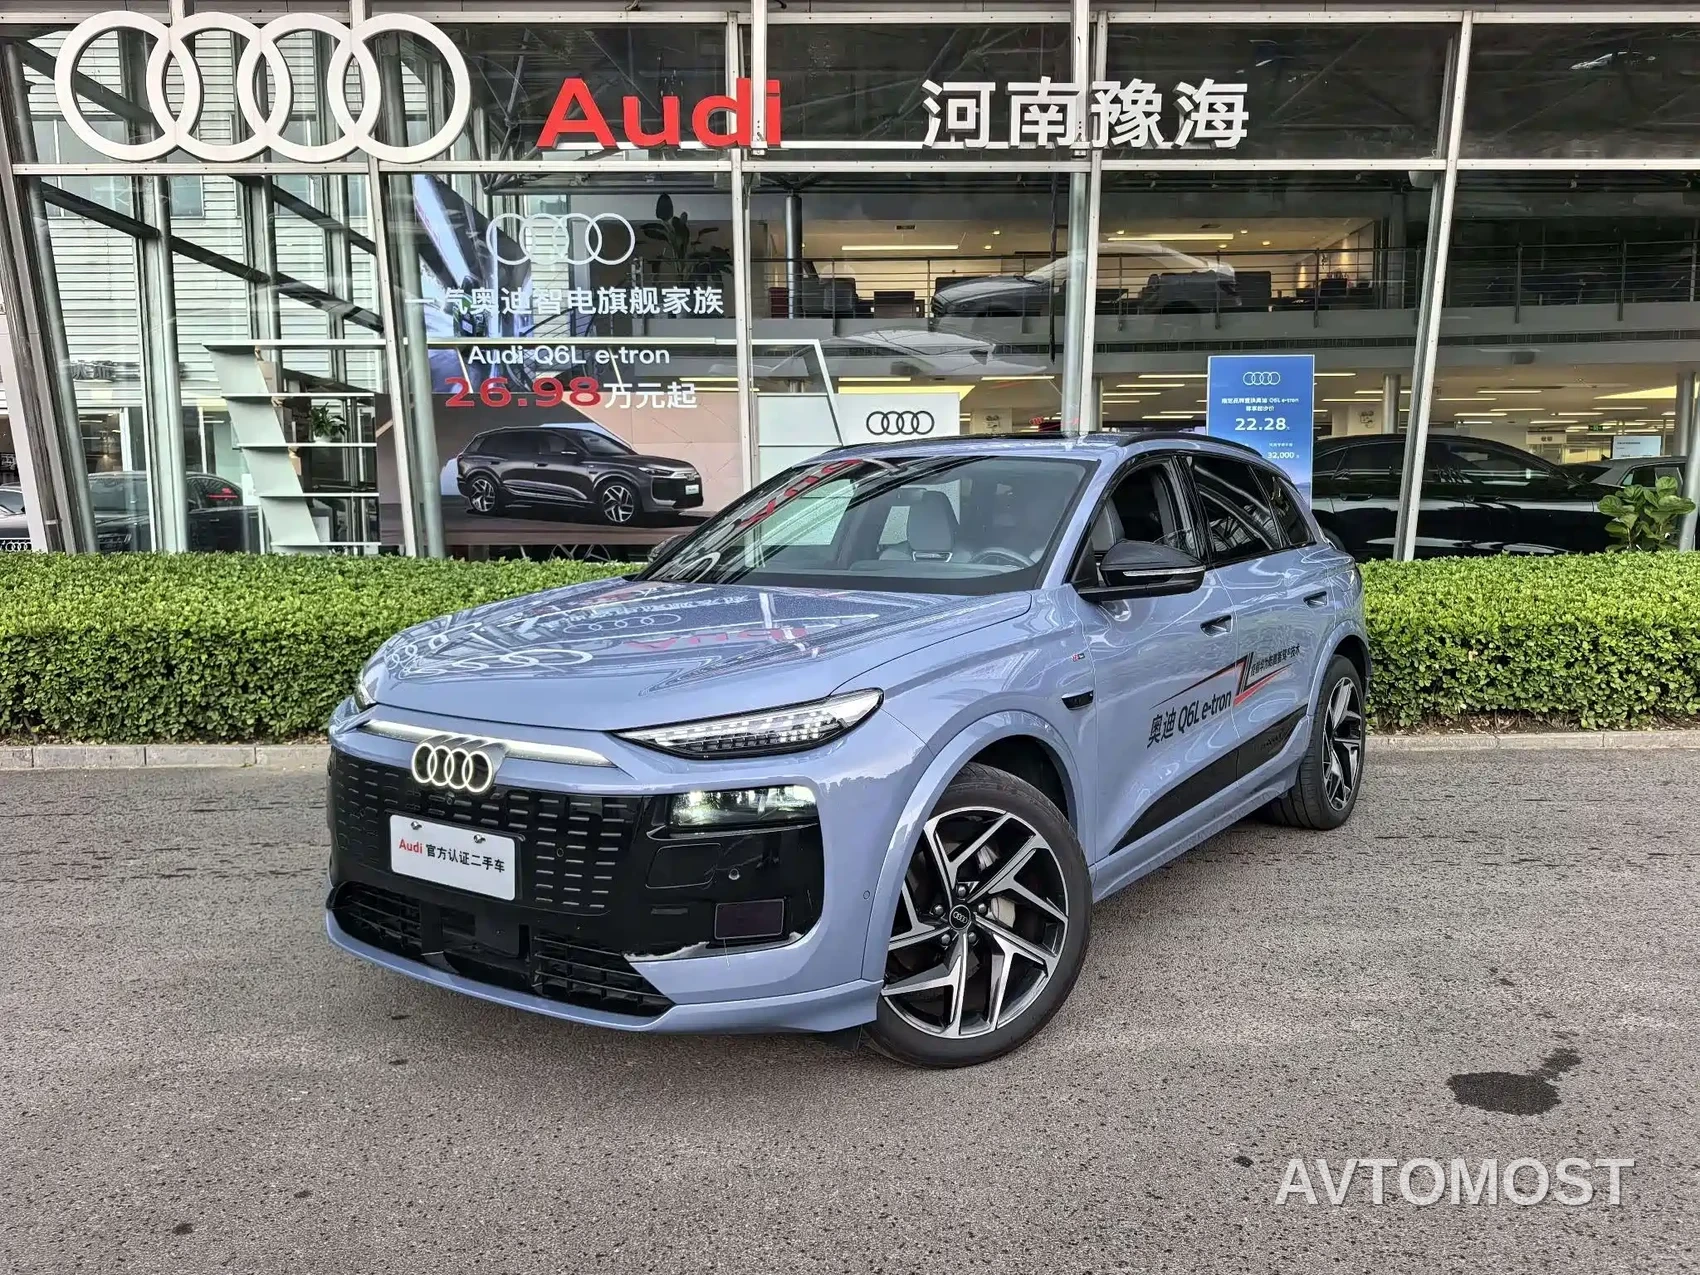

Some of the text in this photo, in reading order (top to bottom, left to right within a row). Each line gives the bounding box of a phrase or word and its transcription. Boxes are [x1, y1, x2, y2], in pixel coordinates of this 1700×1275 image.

[536, 77, 781, 149] Audi
[921, 76, 1249, 149] 河南豫海
[404, 286, 724, 315] 一汽奥迪智电旗舰家族
[468, 345, 670, 366] Audi Q6L e-tron
[1146, 691, 1232, 749] 奥迪 Q6L e-tron
[399, 839, 505, 873] Audi 官方认证二手车
